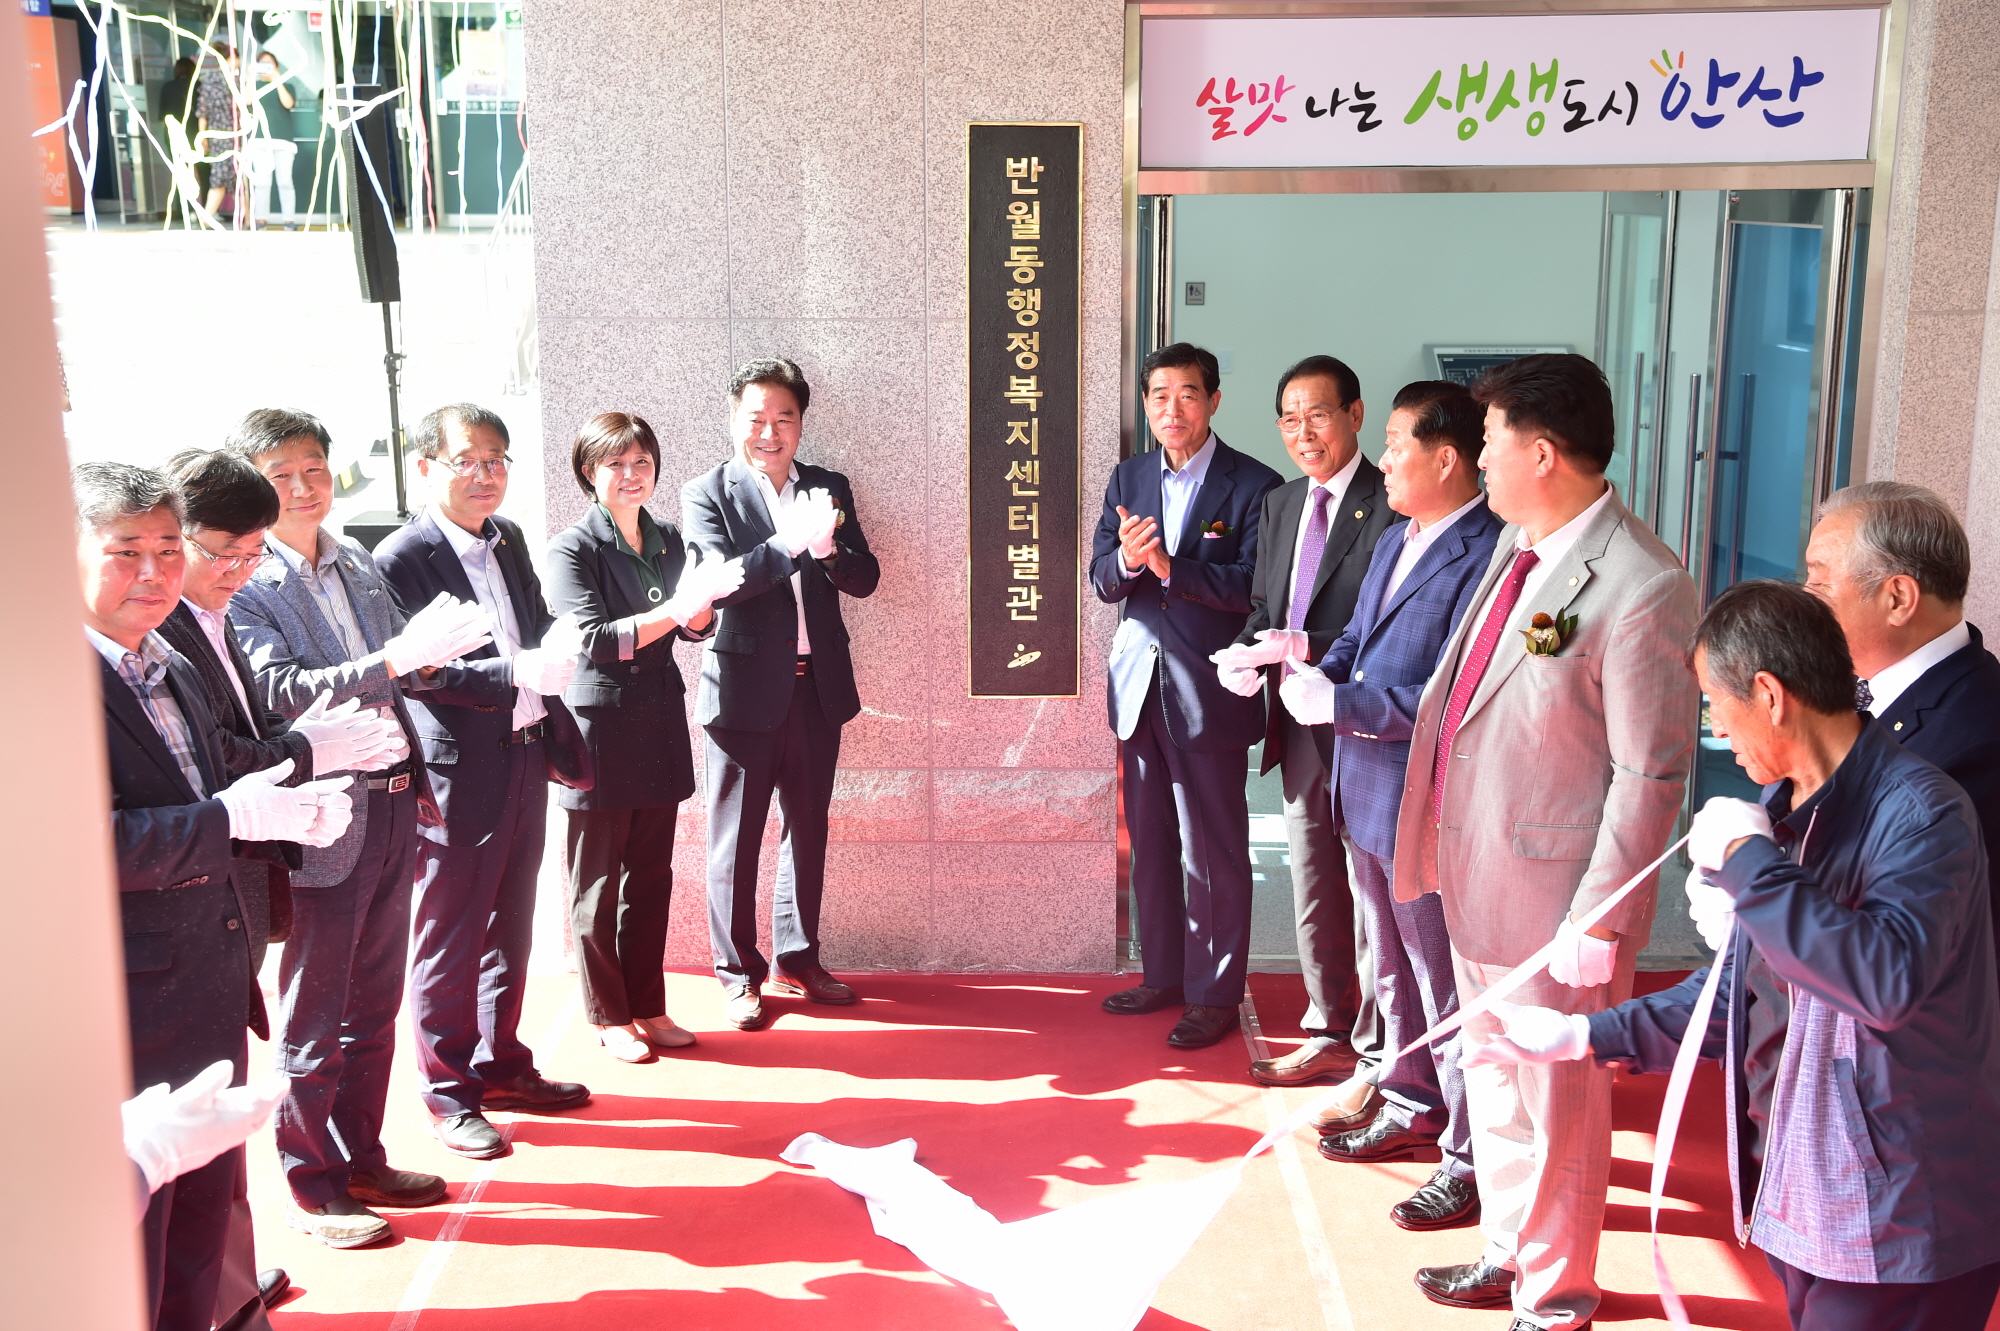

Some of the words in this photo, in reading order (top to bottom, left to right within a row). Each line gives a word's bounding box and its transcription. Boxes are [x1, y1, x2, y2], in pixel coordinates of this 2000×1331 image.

[1196, 75, 1296, 141] 살맛
[1306, 82, 1383, 133] 나는
[1660, 56, 1825, 129] 안산
[1004, 155, 1044, 622] 반월동행정복지센터별관
